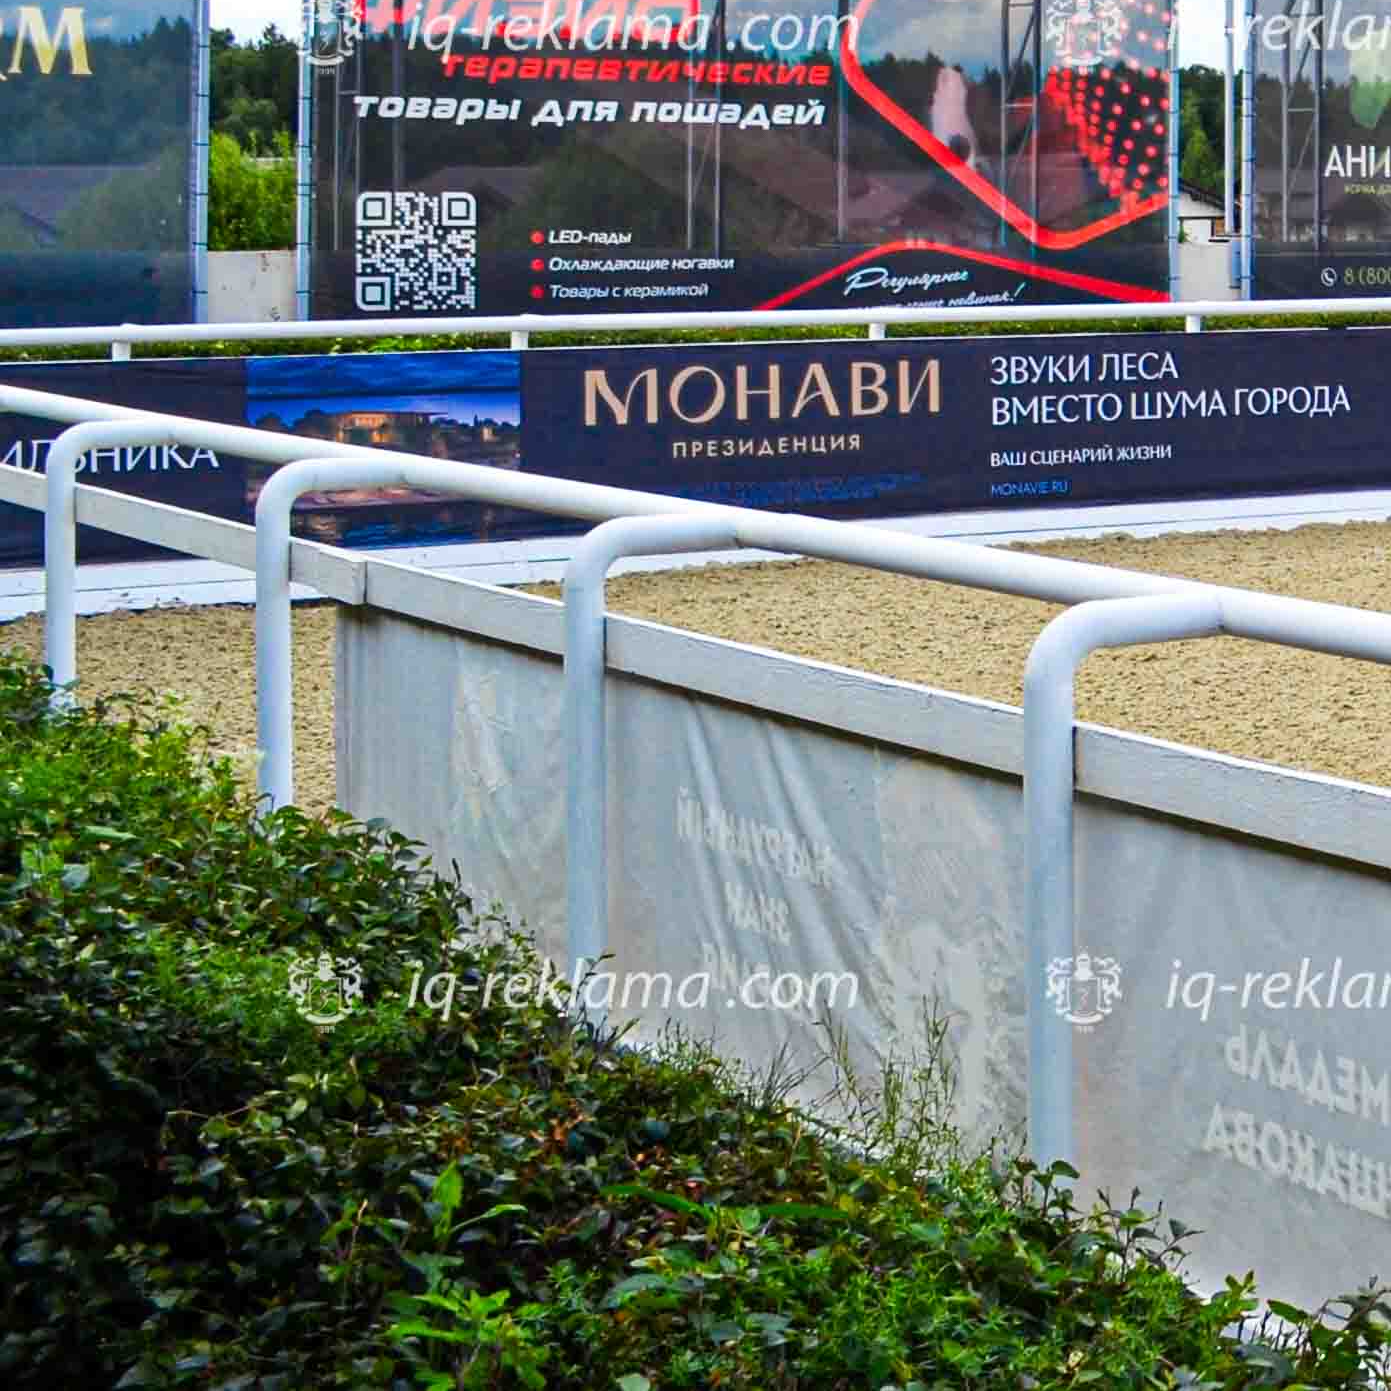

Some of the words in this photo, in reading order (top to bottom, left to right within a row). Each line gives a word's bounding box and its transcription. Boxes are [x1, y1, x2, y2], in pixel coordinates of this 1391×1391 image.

[0, 6, 93, 82] M
[444, 54, 832, 86] терапевтические
[353, 95, 522, 125] товары
[531, 98, 618, 128] для
[548, 229, 632, 246] LED-пады
[549, 255, 669, 274] Охлаждающие
[671, 256, 735, 271] ногавки
[1343, 266, 1355, 285] 8
[549, 284, 608, 300] Товары
[612, 287, 621, 298] с
[624, 281, 709, 299] керамикой
[990, 351, 1094, 386] ЗВУКИ
[1097, 352, 1180, 383] ЛЕСА
[584, 358, 941, 427] МОНАВИ
[992, 393, 1124, 427] ВМЕСТО
[1129, 389, 1228, 422] ШУМА
[1234, 384, 1351, 418] ГОРОДА
[672, 433, 863, 459] ПРЕЗИДЕНЦИЯ
[990, 449, 1027, 468] ВАШ
[1030, 443, 1114, 467] СЦЕНАРИЙ
[1117, 444, 1173, 462] ЖИЗНИ
